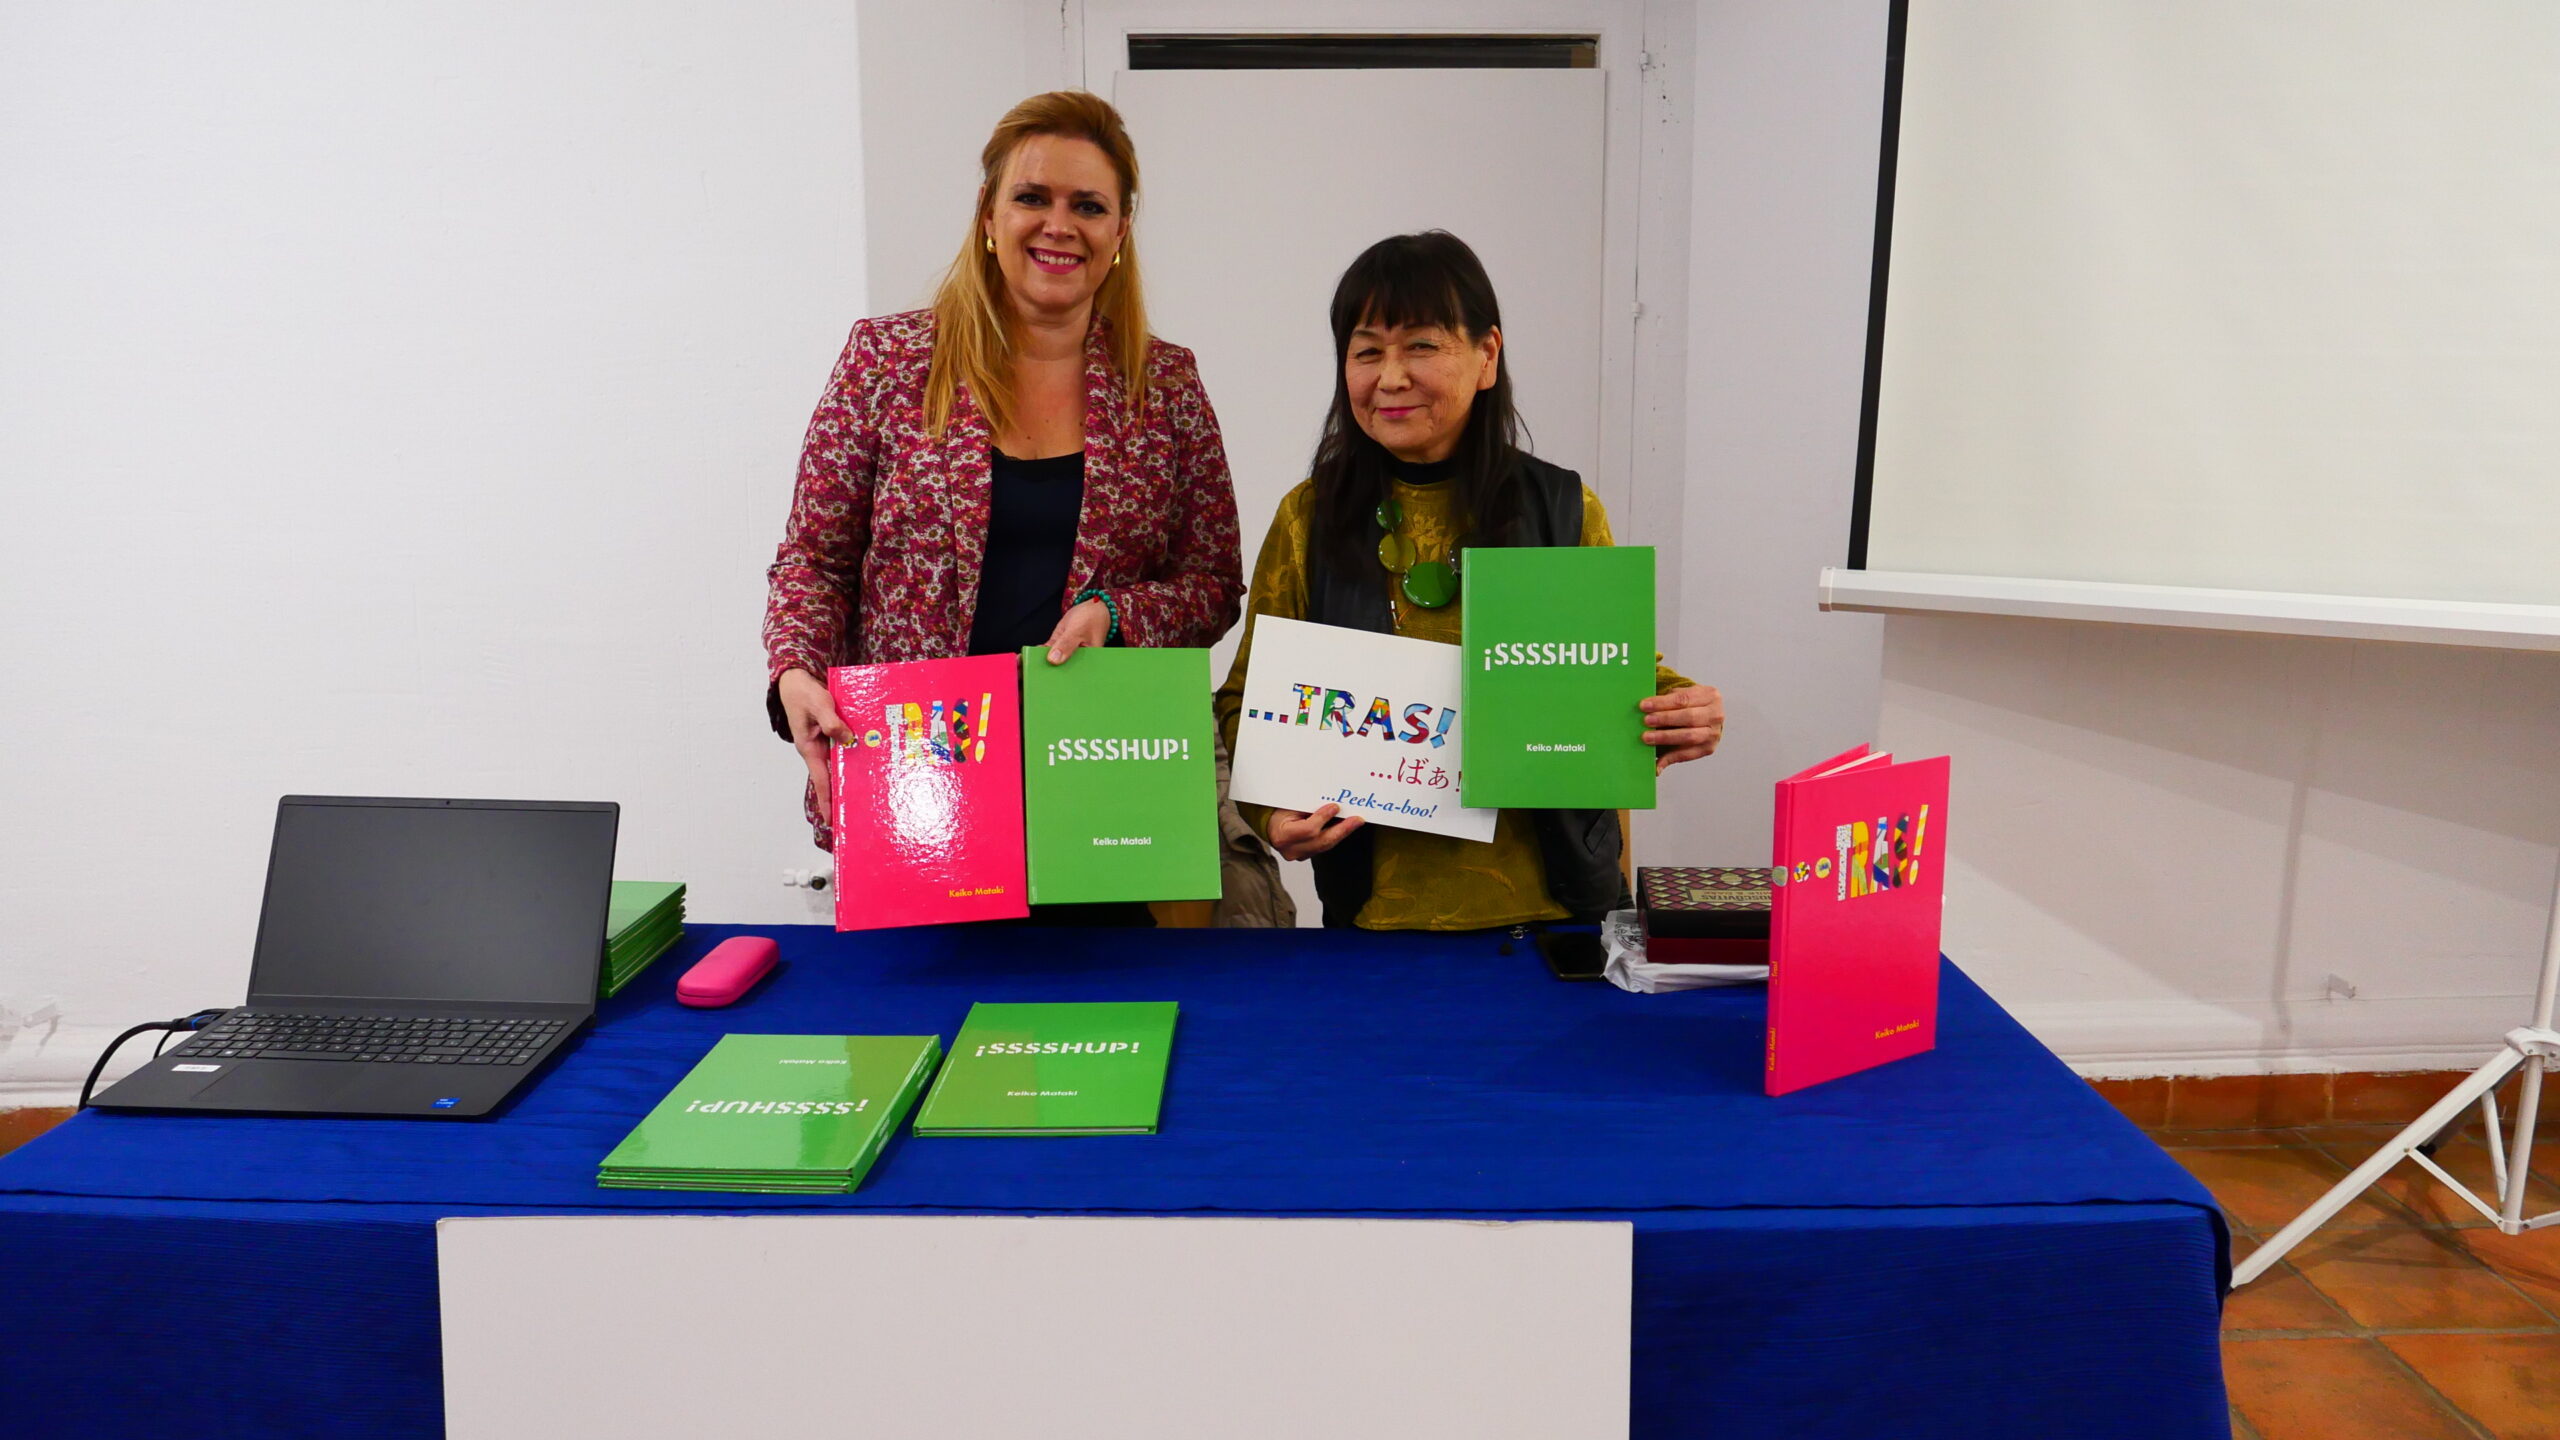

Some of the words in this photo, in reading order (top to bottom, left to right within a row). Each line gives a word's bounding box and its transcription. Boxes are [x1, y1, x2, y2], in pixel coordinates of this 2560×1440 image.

[1484, 642, 1629, 671] ¡SSSSHUP!
[1248, 683, 1457, 749] ...TRAS!
[1048, 738, 1190, 766] ¡SSSSHUP!
[1526, 743, 1552, 752] Keiko
[1554, 743, 1586, 752] Mataki
[1093, 837, 1119, 846] Keiko
[1120, 836, 1152, 846] Mataki
[949, 888, 973, 898] Keiko
[974, 886, 1005, 896] Mataki
[1874, 1029, 1895, 1040] Keiko
[1896, 1020, 1920, 1034] Mataki
[974, 1042, 1140, 1057] ¡SSSSHUP!
[685, 1099, 870, 1115] ¡SSSSHUP!
